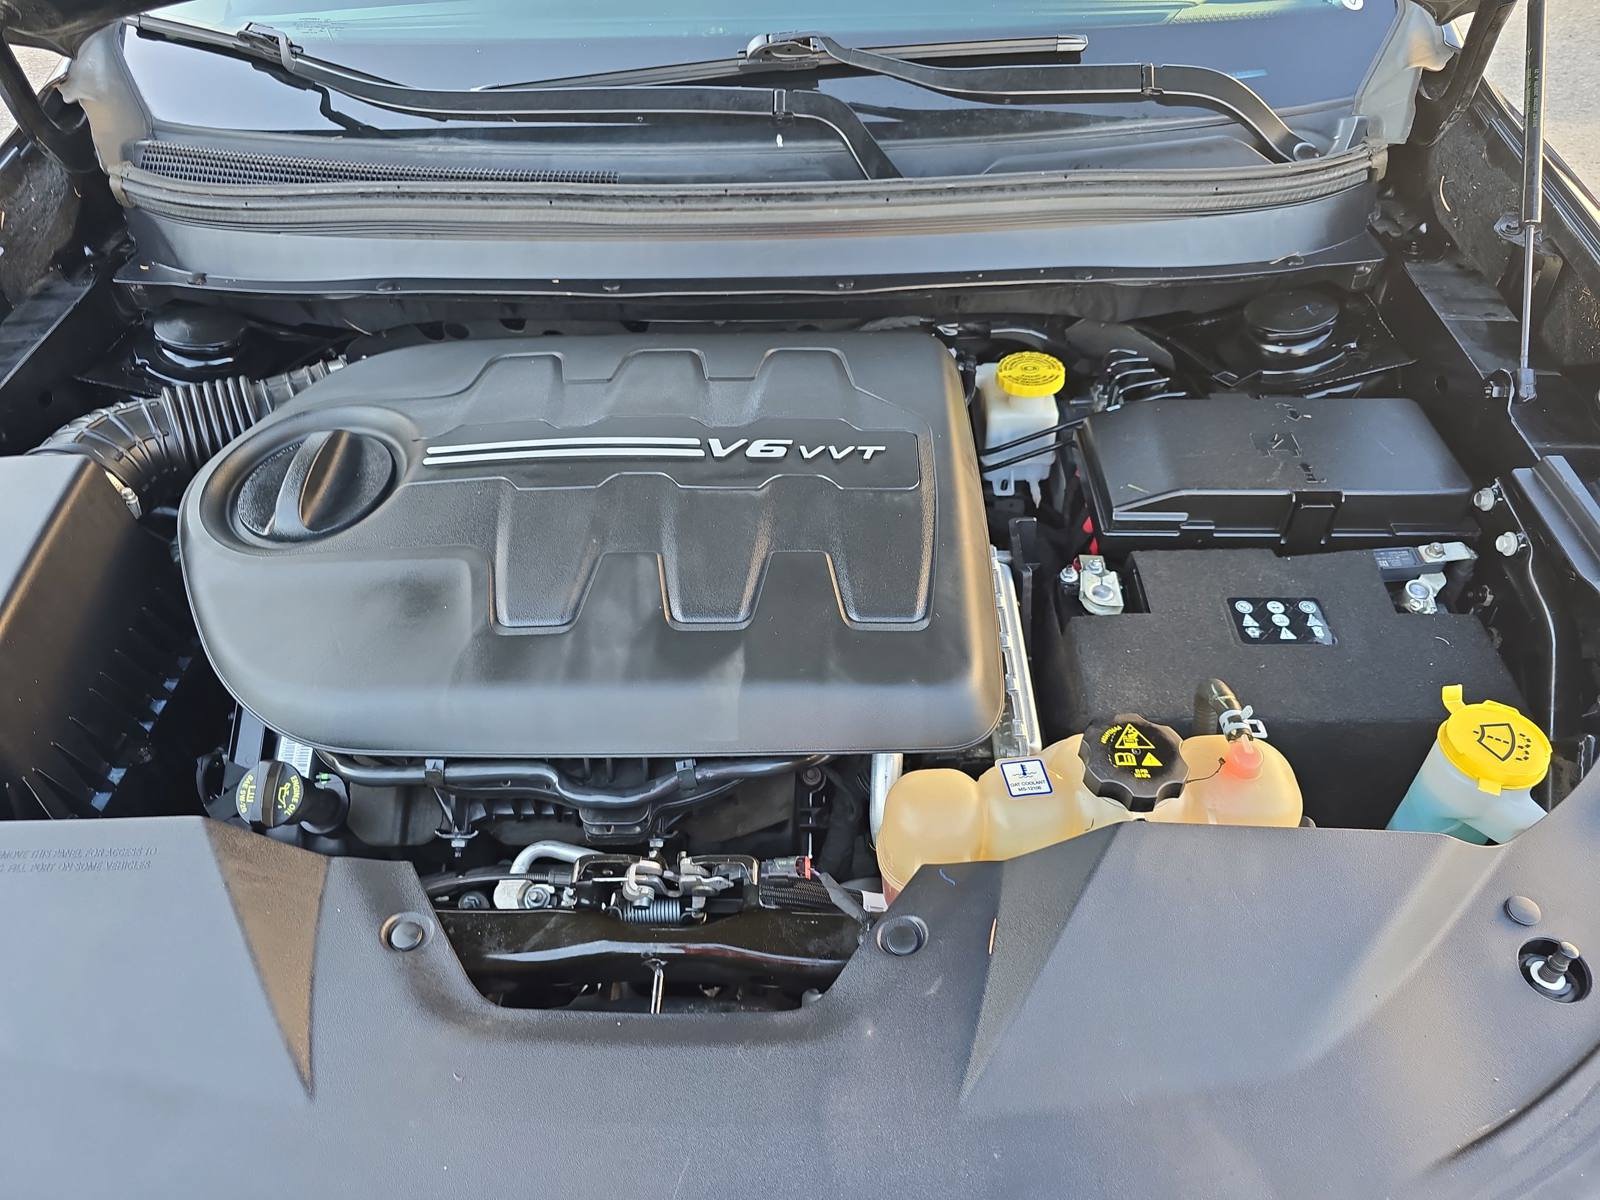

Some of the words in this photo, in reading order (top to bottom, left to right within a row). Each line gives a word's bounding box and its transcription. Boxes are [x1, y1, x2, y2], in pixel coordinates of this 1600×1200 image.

[707, 438, 794, 458] V6
[799, 445, 887, 460] VVT
[290, 775, 301, 804] ENGINE
[284, 804, 296, 816] OIL
[53, 848, 83, 859] PANEL
[84, 848, 105, 858] FOR
[106, 847, 143, 858] ACCESS
[145, 846, 159, 857] TO
[58, 861, 74, 872] ON
[74, 861, 103, 872] SOME
[105, 860, 152, 872] VEHICLES
